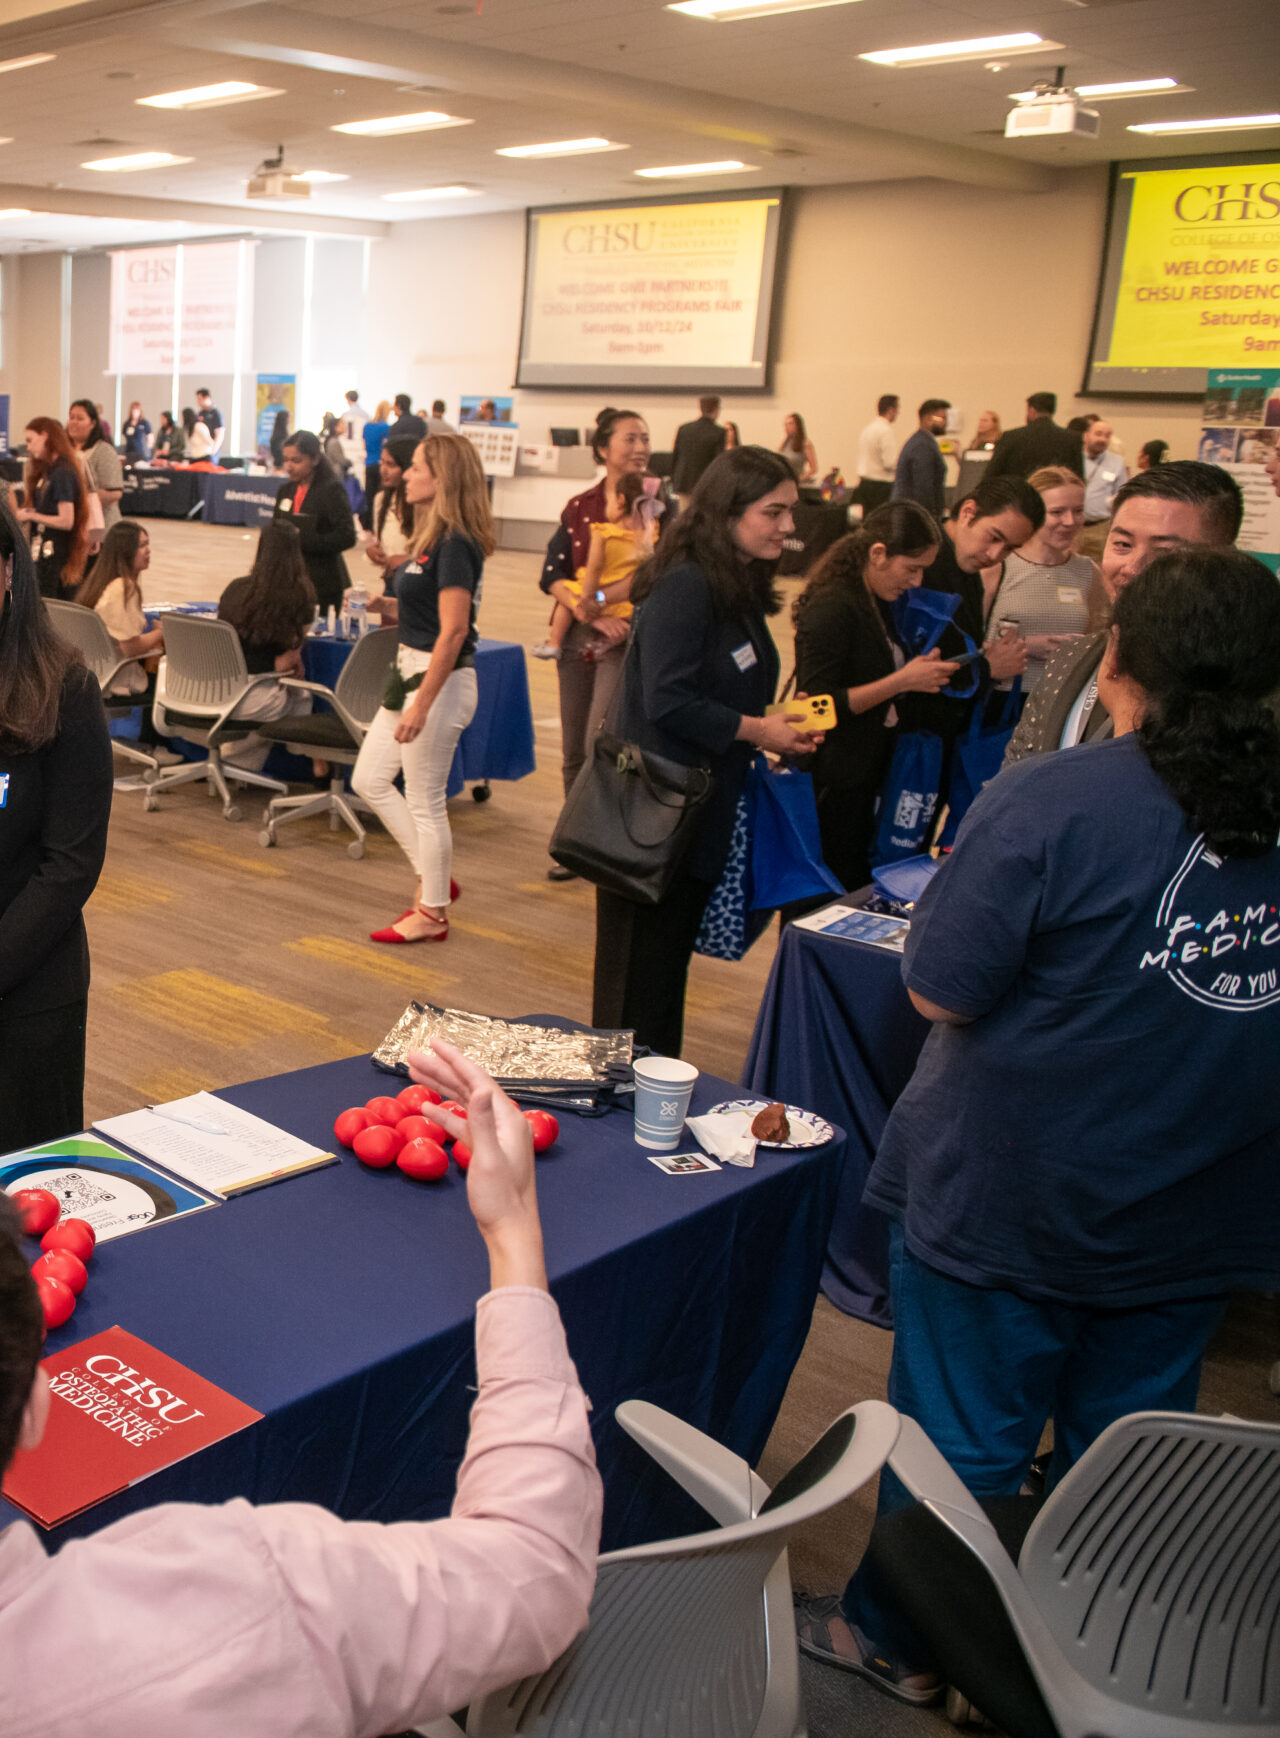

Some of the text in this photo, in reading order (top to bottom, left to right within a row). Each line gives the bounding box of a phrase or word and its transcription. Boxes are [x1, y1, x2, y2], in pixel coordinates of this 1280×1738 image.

[562, 221, 657, 254] CHSU
[128, 259, 176, 283] CHS
[1163, 259, 1259, 276] WELCOME
[640, 300, 711, 313] PROGRAMS
[715, 300, 744, 313] FAIR
[1136, 286, 1185, 302] CHSU
[1210, 968, 1276, 997] FOR YOU
[71, 1367, 172, 1431] COLLEGE OF
[85, 1354, 205, 1424] CHSU
[48, 1376, 151, 1447] MEDICINE
[59, 1371, 165, 1439] OSTEOPATHIC
